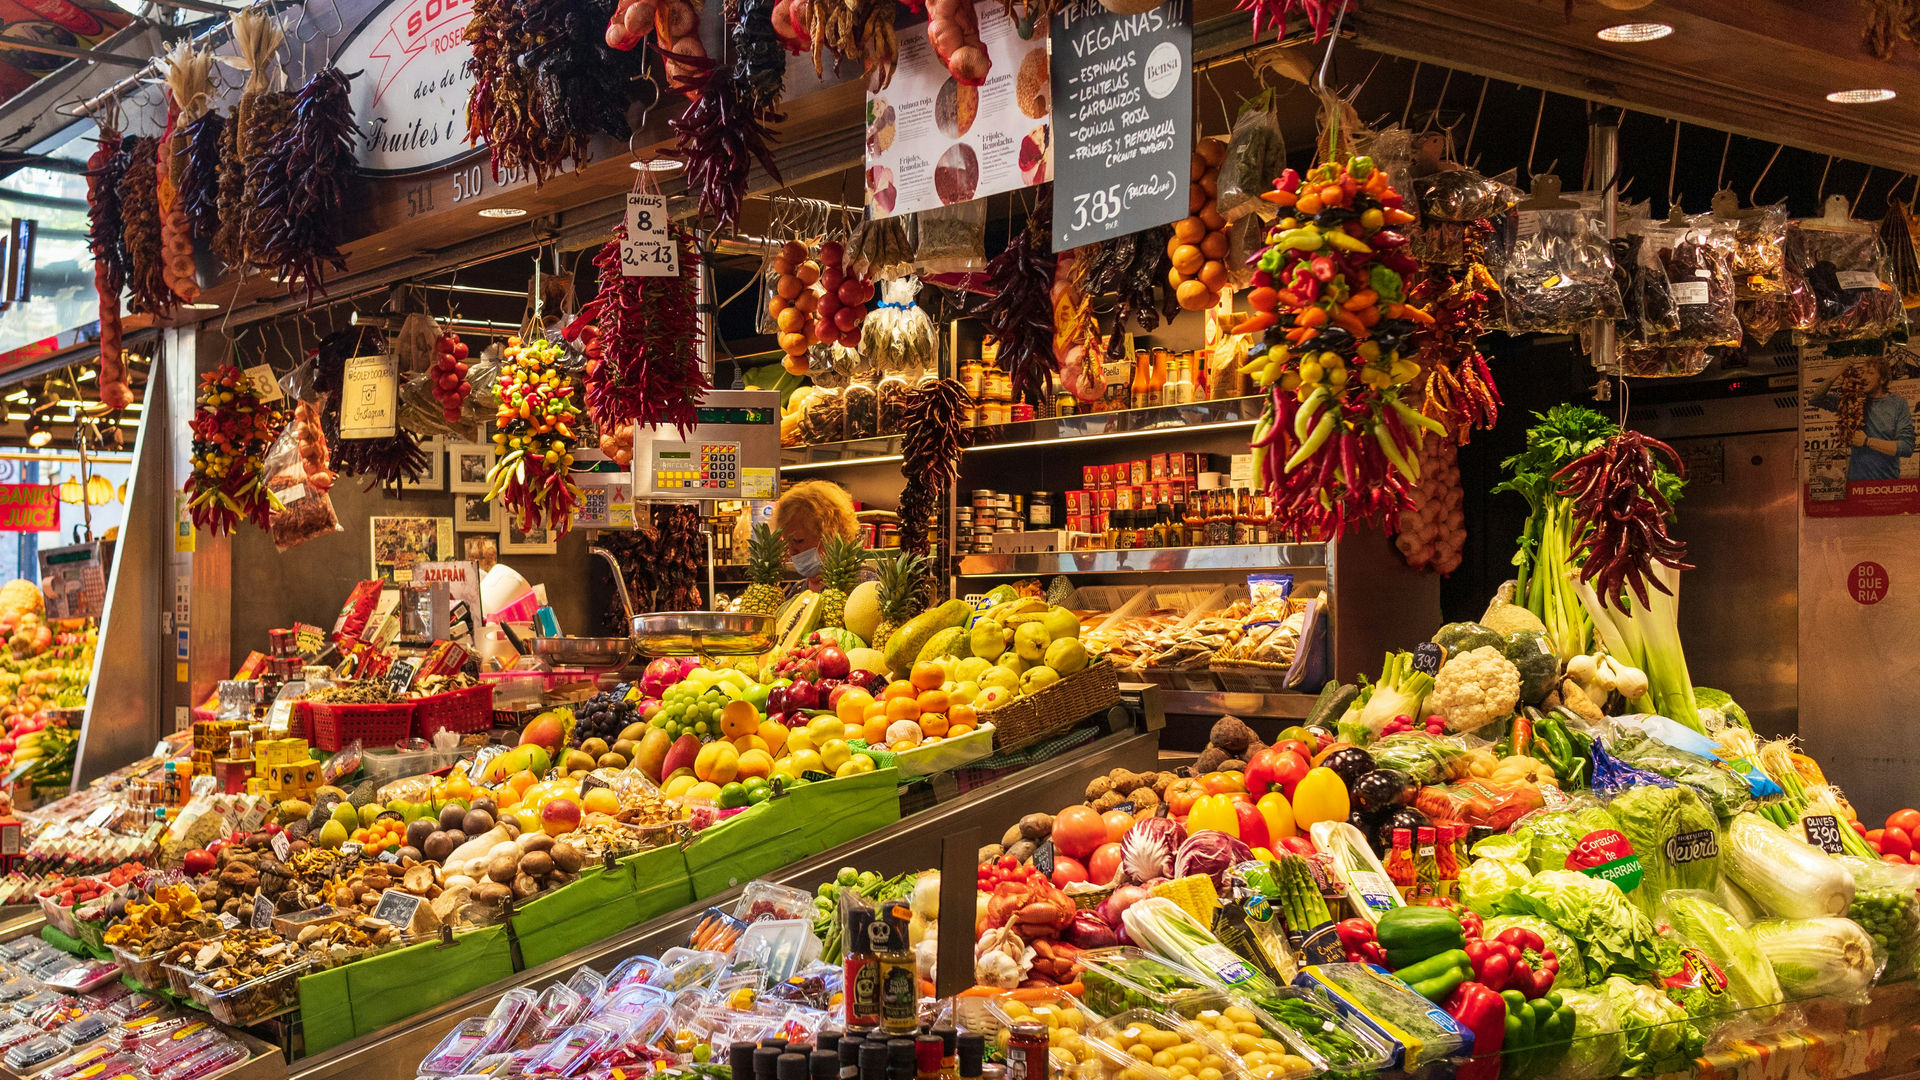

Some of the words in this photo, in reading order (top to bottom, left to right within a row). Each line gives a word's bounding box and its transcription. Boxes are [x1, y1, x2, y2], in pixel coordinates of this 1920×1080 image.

[1080, 50, 1137, 83] ESPINACAS
[1147, 58, 1179, 80] Bensa
[414, 80, 436, 100] des
[440, 69, 455, 90] de
[1080, 72, 1130, 102] LENTEJAS
[1079, 87, 1141, 122] GARBANZOS
[1121, 105, 1150, 128] ROJA
[366, 117, 440, 152] Fruites
[446, 109, 456, 141] i
[408, 181, 435, 217] 511
[452, 165, 482, 203] 510
[1070, 184, 1121, 232] 3.85
[637, 210, 653, 231] 8
[1103, 365, 1120, 377] Paella
[258, 375, 274, 395] 8
[1852, 487, 1864, 496] MI
[1866, 484, 1919, 495] BOQUERIA
[4, 508, 55, 526] JUICE
[424, 565, 466, 582] AZAFRÁN
[1858, 565, 1875, 577] BO
[1858, 577, 1883, 589] QUE
[1858, 590, 1879, 601] RIA
[1806, 816, 1835, 827] OLIVES
[1579, 832, 1621, 854] Corazón
[1605, 850, 1617, 862] de
